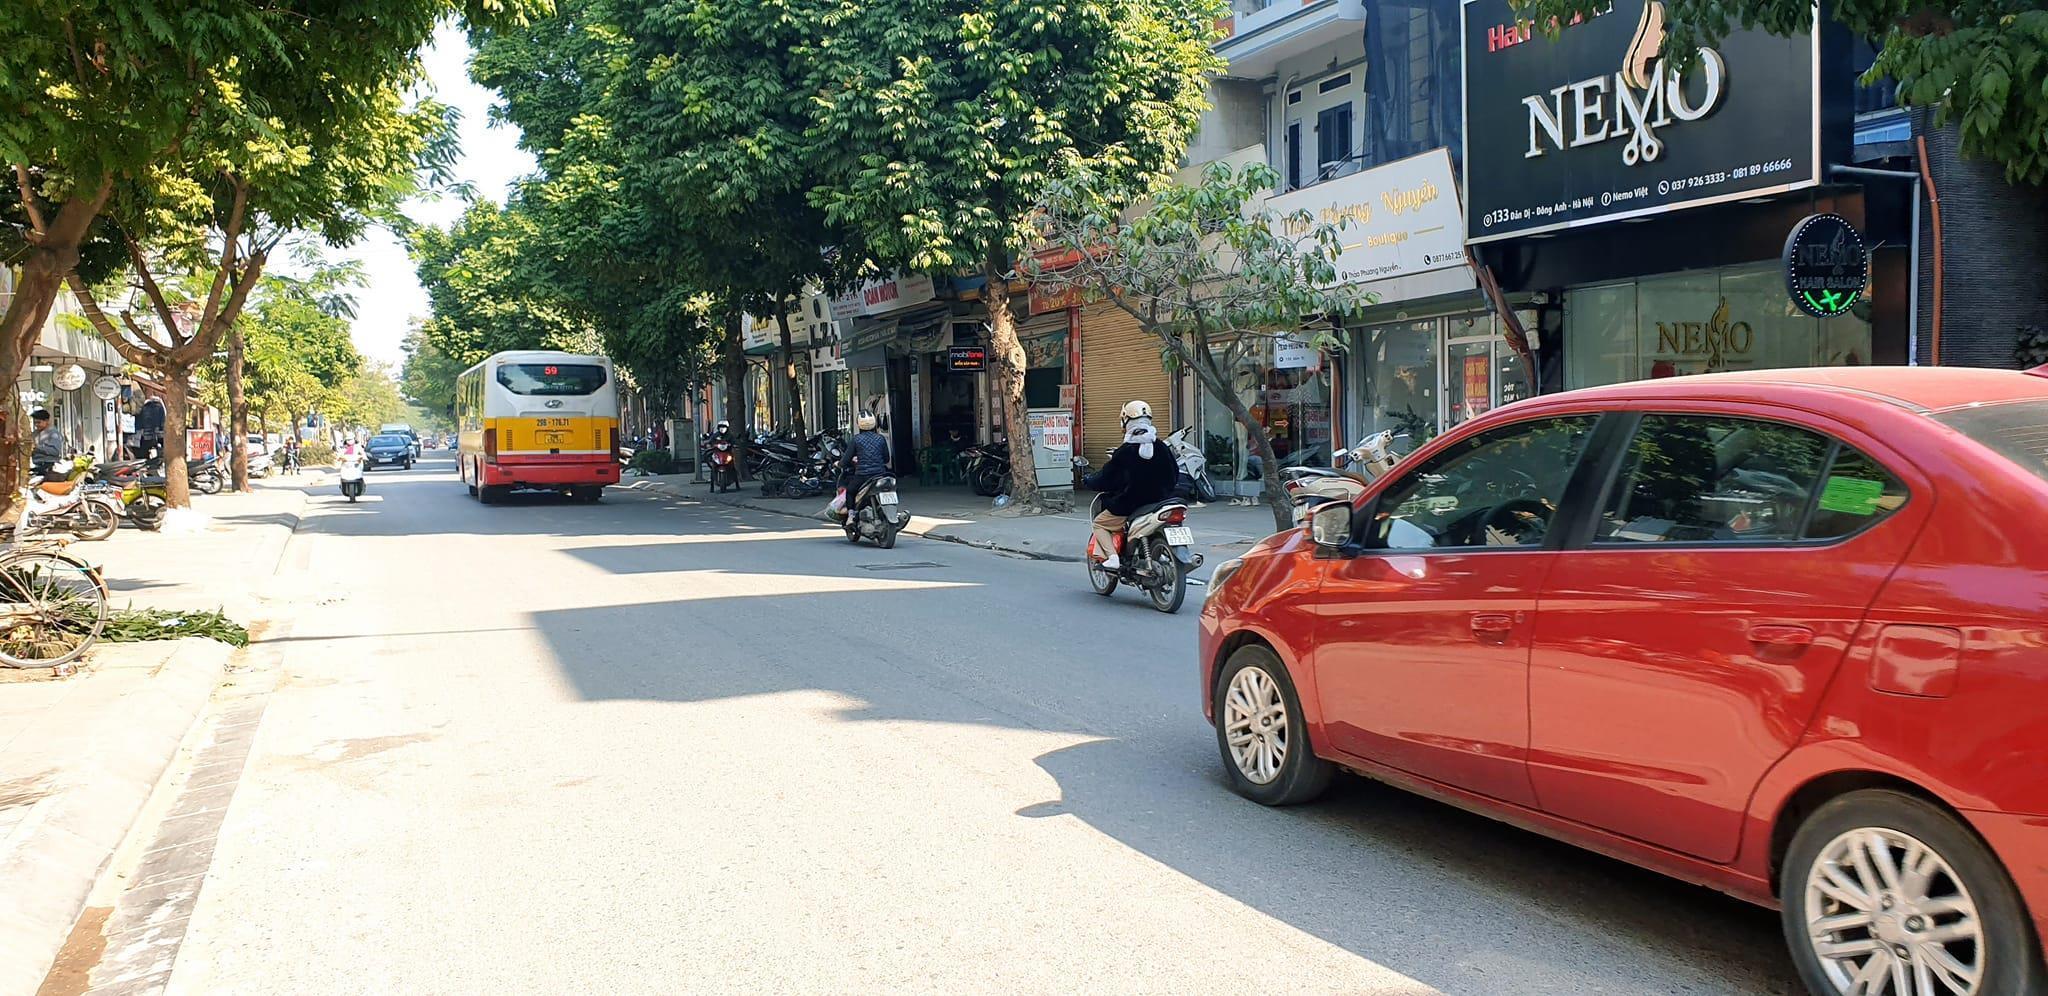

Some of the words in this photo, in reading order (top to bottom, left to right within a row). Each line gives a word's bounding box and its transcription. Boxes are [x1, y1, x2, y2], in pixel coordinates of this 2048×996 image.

[1522, 47, 1725, 159] NEMO
[1671, 181, 1686, 191] 037
[1733, 168, 1748, 179] 081
[1750, 164, 1761, 176] 89
[1763, 158, 1792, 173] 66666
[1612, 191, 1633, 202] Nemo
[1634, 186, 1649, 198] Việt
[1491, 208, 1510, 224] 133
[1554, 203, 1567, 213] Anh
[1572, 199, 1582, 209] Hà
[1583, 197, 1594, 209] Nội
[1656, 321, 1753, 354] NEMO
[544, 366, 559, 376] 59
